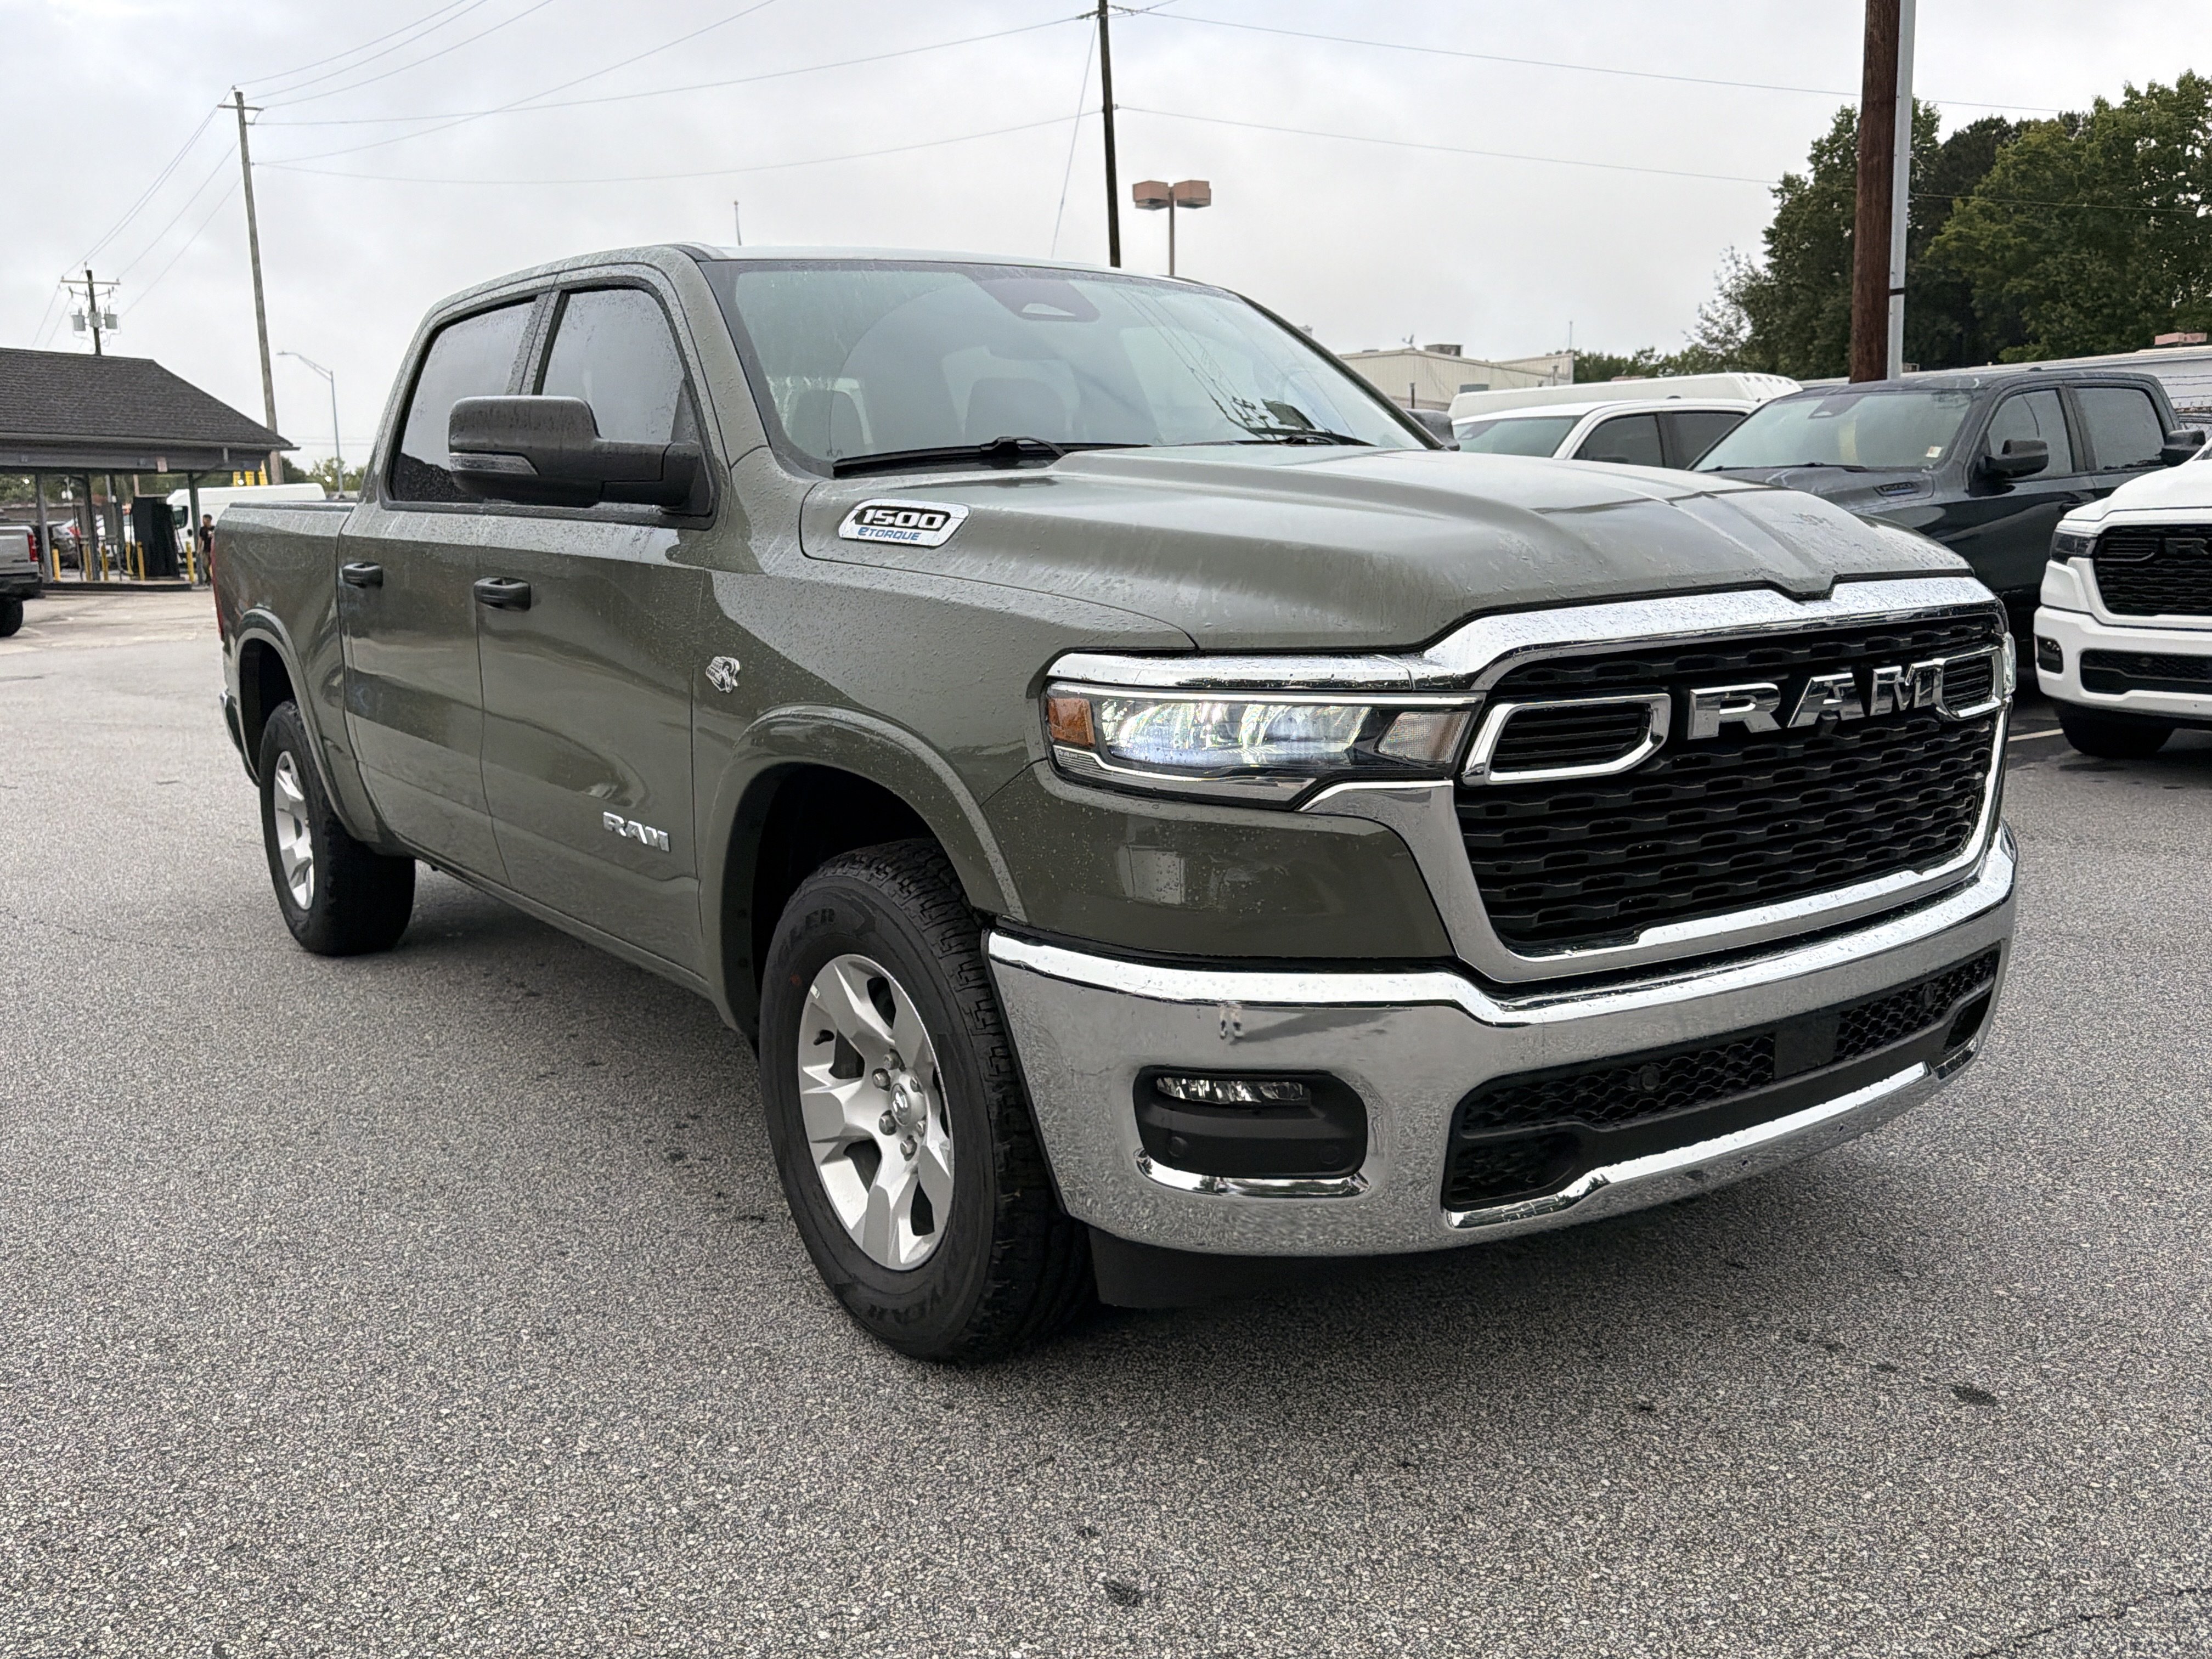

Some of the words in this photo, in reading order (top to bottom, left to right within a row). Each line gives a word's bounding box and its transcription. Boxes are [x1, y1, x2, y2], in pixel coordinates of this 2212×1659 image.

[862, 509, 946, 529] 1500
[1688, 660, 1938, 740] RAM
[603, 811, 670, 852] RAM
